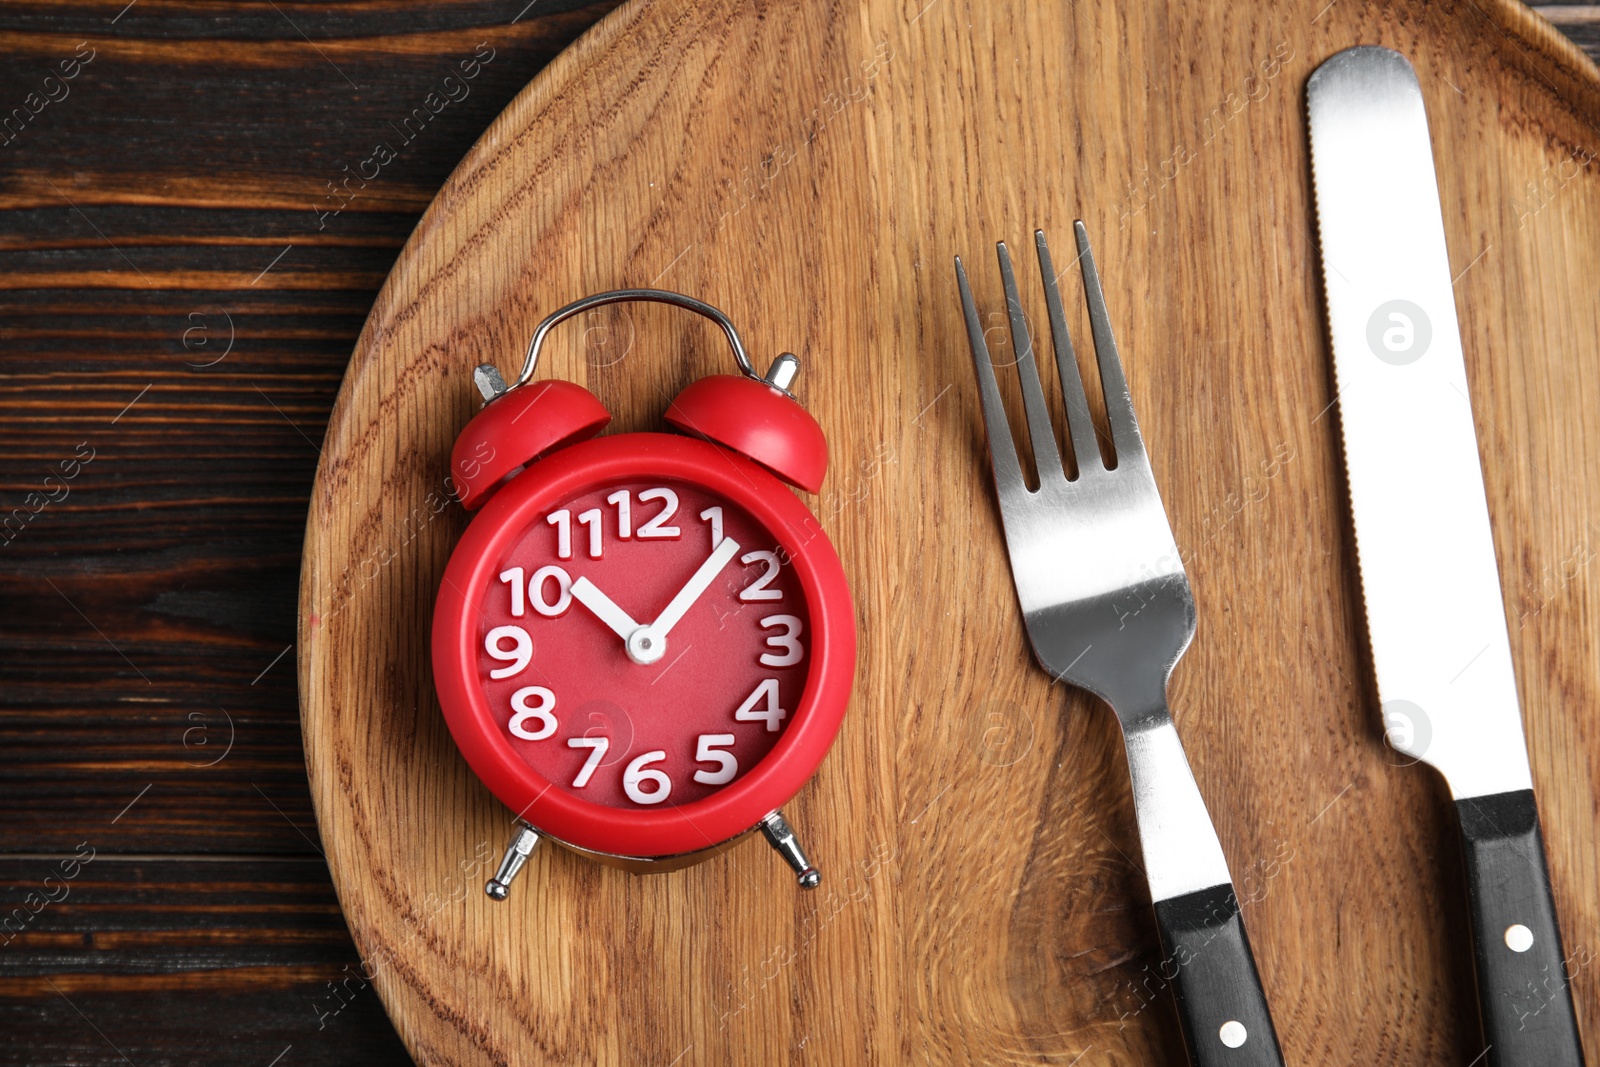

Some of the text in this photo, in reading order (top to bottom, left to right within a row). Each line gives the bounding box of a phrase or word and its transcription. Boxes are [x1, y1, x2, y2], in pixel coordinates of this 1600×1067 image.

[546, 508, 602, 557] 11
[608, 487, 681, 538] 12
[700, 506, 725, 555] 1
[500, 565, 573, 617] 10
[739, 550, 783, 601] 2
[484, 625, 533, 679] 9
[759, 614, 804, 667] 3
[508, 686, 558, 740] 8
[735, 679, 785, 731] 4
[567, 737, 609, 787] 7
[623, 751, 672, 804] 6
[693, 734, 738, 784] 5
